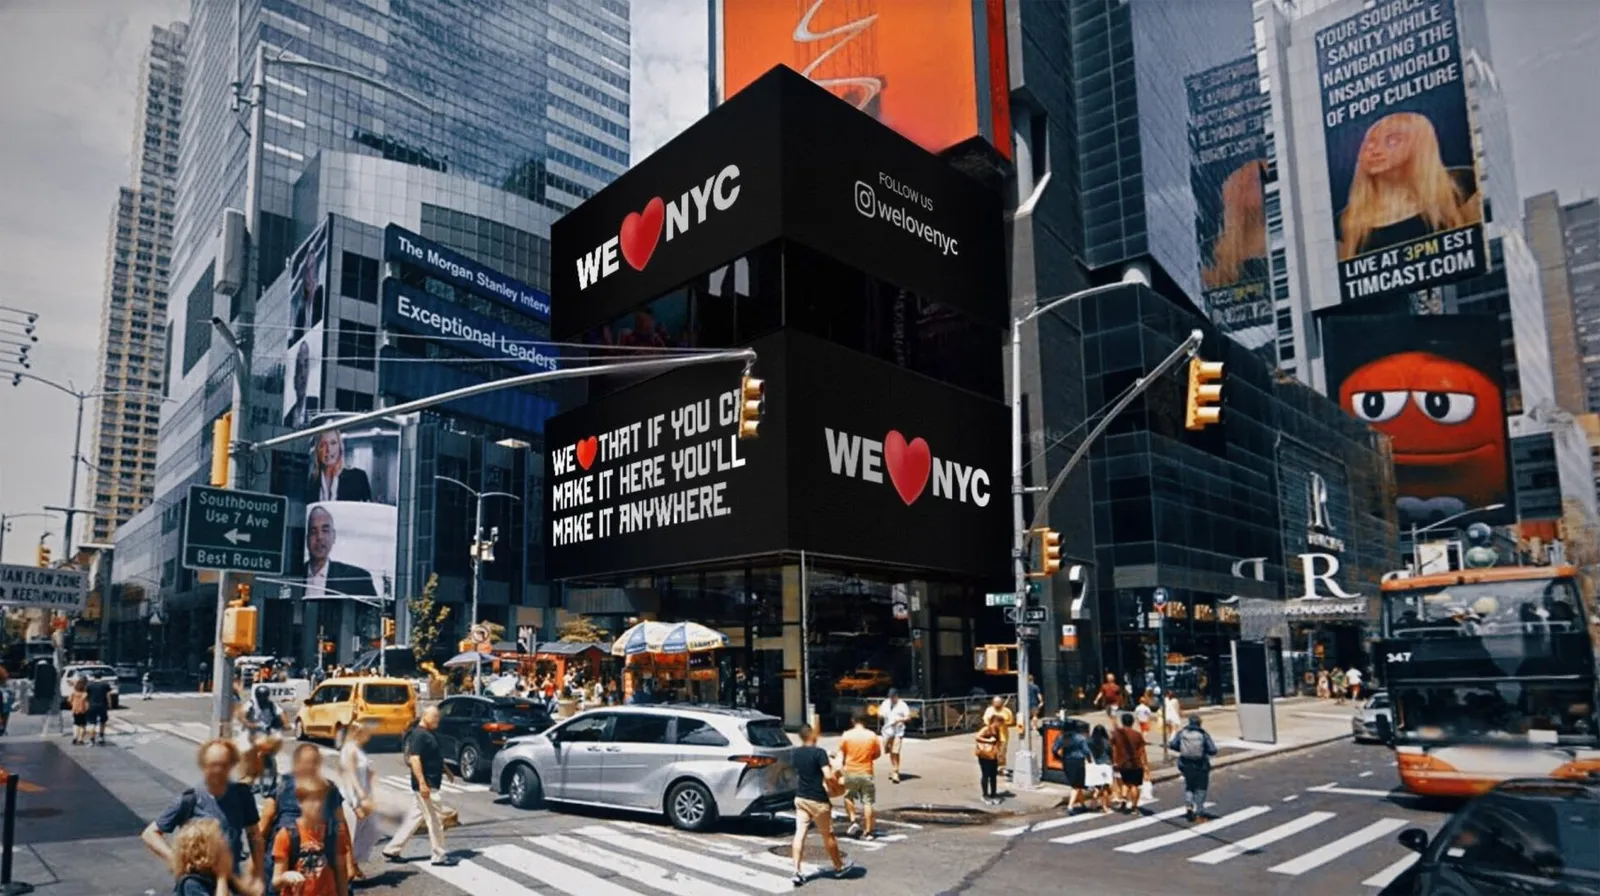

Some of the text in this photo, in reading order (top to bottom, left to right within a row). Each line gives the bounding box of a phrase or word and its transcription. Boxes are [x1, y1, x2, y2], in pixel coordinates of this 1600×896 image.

[1317, 20, 1357, 49] YOUR
[1323, 20, 1453, 88] NAVIGATING THE
[1328, 4, 1442, 65] SANITY WHILE
[1326, 62, 1459, 127] OF POP CULTURE
[1328, 45, 1450, 106] INSANE WORLD
[879, 171, 933, 211] FOLLOW US
[576, 164, 741, 291] WE NYC
[877, 200, 959, 256] welovenyc
[1345, 229, 1473, 278] LIVE AT 3PM EST
[398, 236, 550, 316] The Morgan Stanley Interv
[1346, 249, 1475, 299] TIMCAST.COM
[398, 295, 557, 371] Exceptional Leaders
[552, 444, 576, 477] WE
[598, 421, 642, 462] THAT
[647, 413, 665, 449] IF
[671, 398, 710, 440] YOU
[824, 427, 991, 507] WE NYC
[199, 491, 279, 514] Southbound
[552, 434, 746, 512] MAKE IT HERE YOU'LL
[205, 509, 269, 528] Use 7 Ave
[552, 481, 732, 547] MAKE IT ANYWHERE.
[25, 570, 54, 586] FLOW
[56, 573, 81, 589] ZONE
[197, 549, 272, 569] Best Route
[1297, 552, 1361, 600] R
